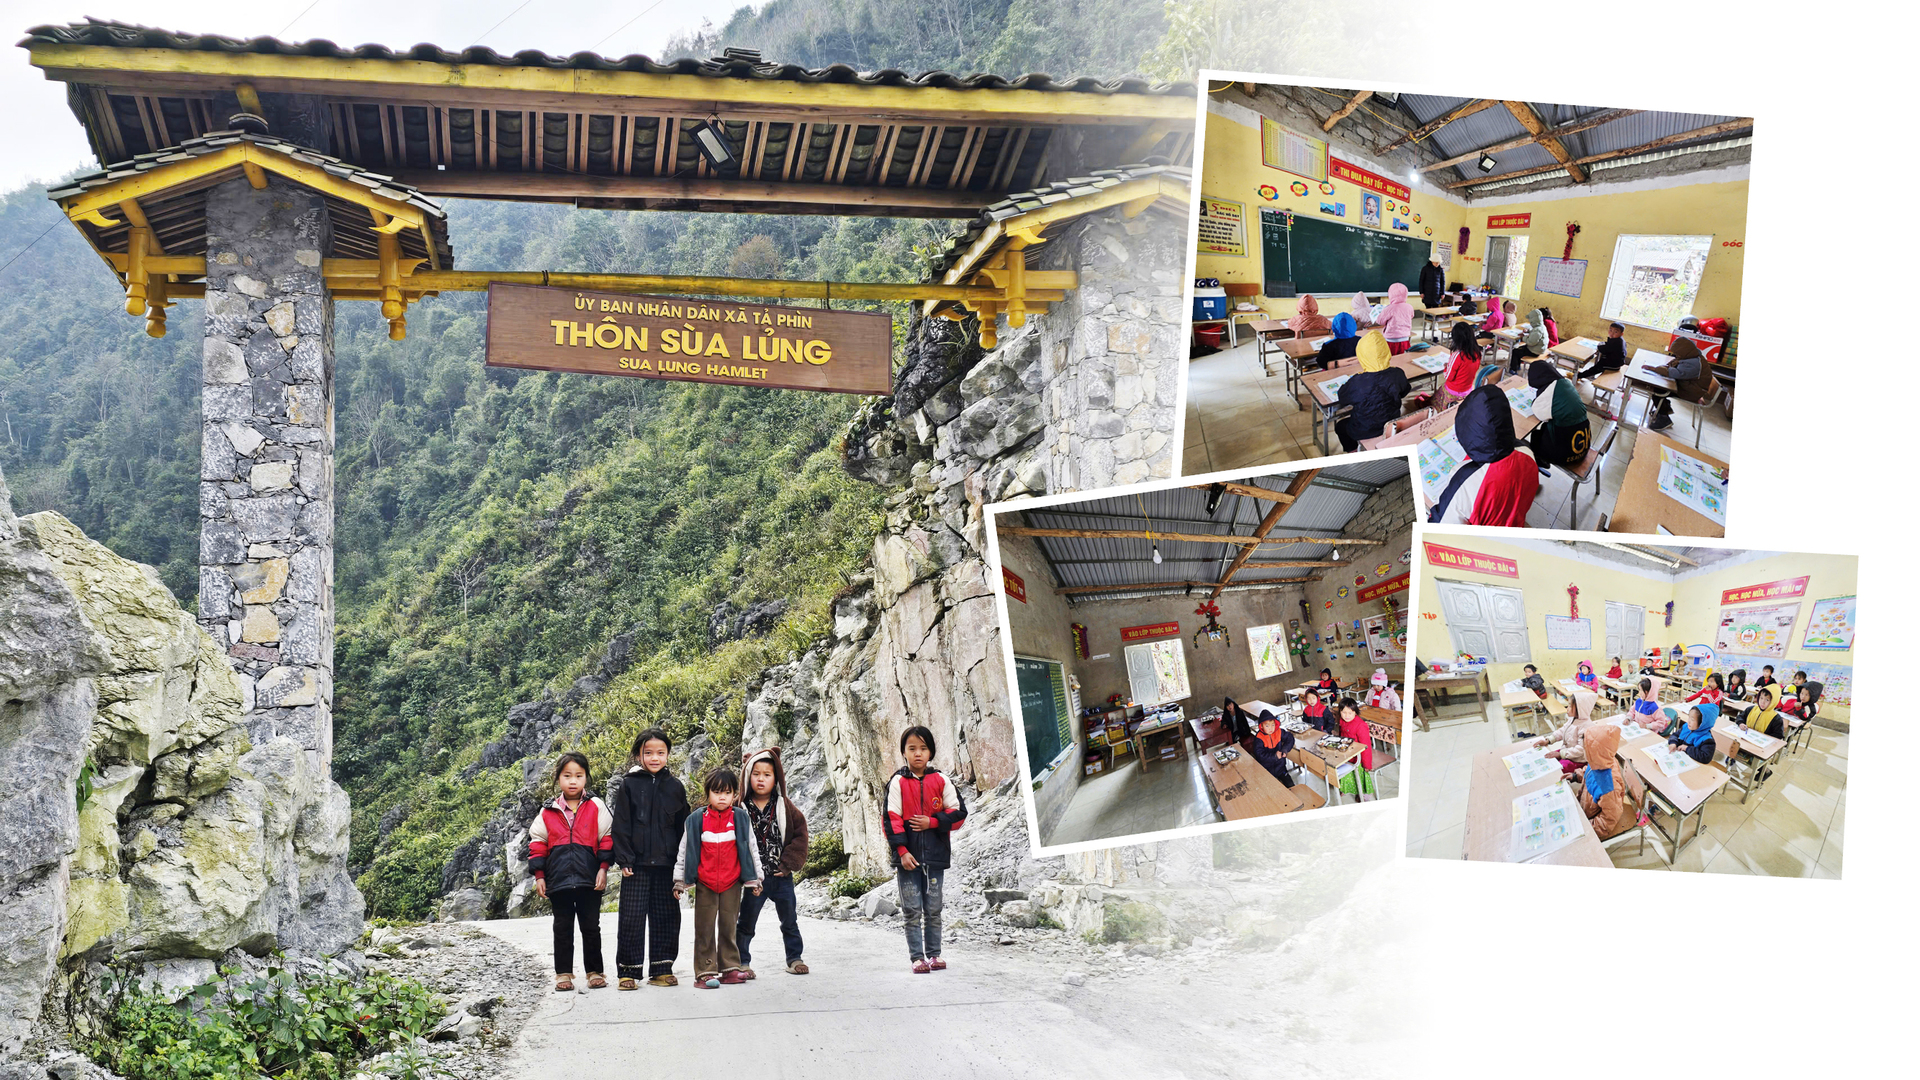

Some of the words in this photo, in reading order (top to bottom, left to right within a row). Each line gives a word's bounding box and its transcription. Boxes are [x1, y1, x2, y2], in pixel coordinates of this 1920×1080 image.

[1340, 167, 1350, 178] THI
[1351, 170, 1362, 182] ĐUA
[1363, 175, 1373, 187] DẠY
[1374, 179, 1383, 190] TỐT
[1386, 184, 1396, 195] HỌC
[575, 293, 596, 311] ỦY
[600, 299, 633, 314] BAN
[637, 301, 682, 318] NHÂN
[686, 304, 720, 321] DÂN
[753, 308, 772, 325] TẢ
[777, 310, 812, 329] PHÌN
[551, 316, 648, 352] THÔN
[660, 322, 731, 358] SÙA
[742, 328, 832, 365] LỦNG
[619, 357, 652, 371] SUA
[658, 360, 701, 374] LUNG
[706, 364, 768, 379] HAMLET
[1438, 551, 1457, 564] VÀO
[1457, 554, 1472, 567] LỚP
[1473, 558, 1497, 572] THUỘC
[1497, 562, 1509, 573] BÀI
